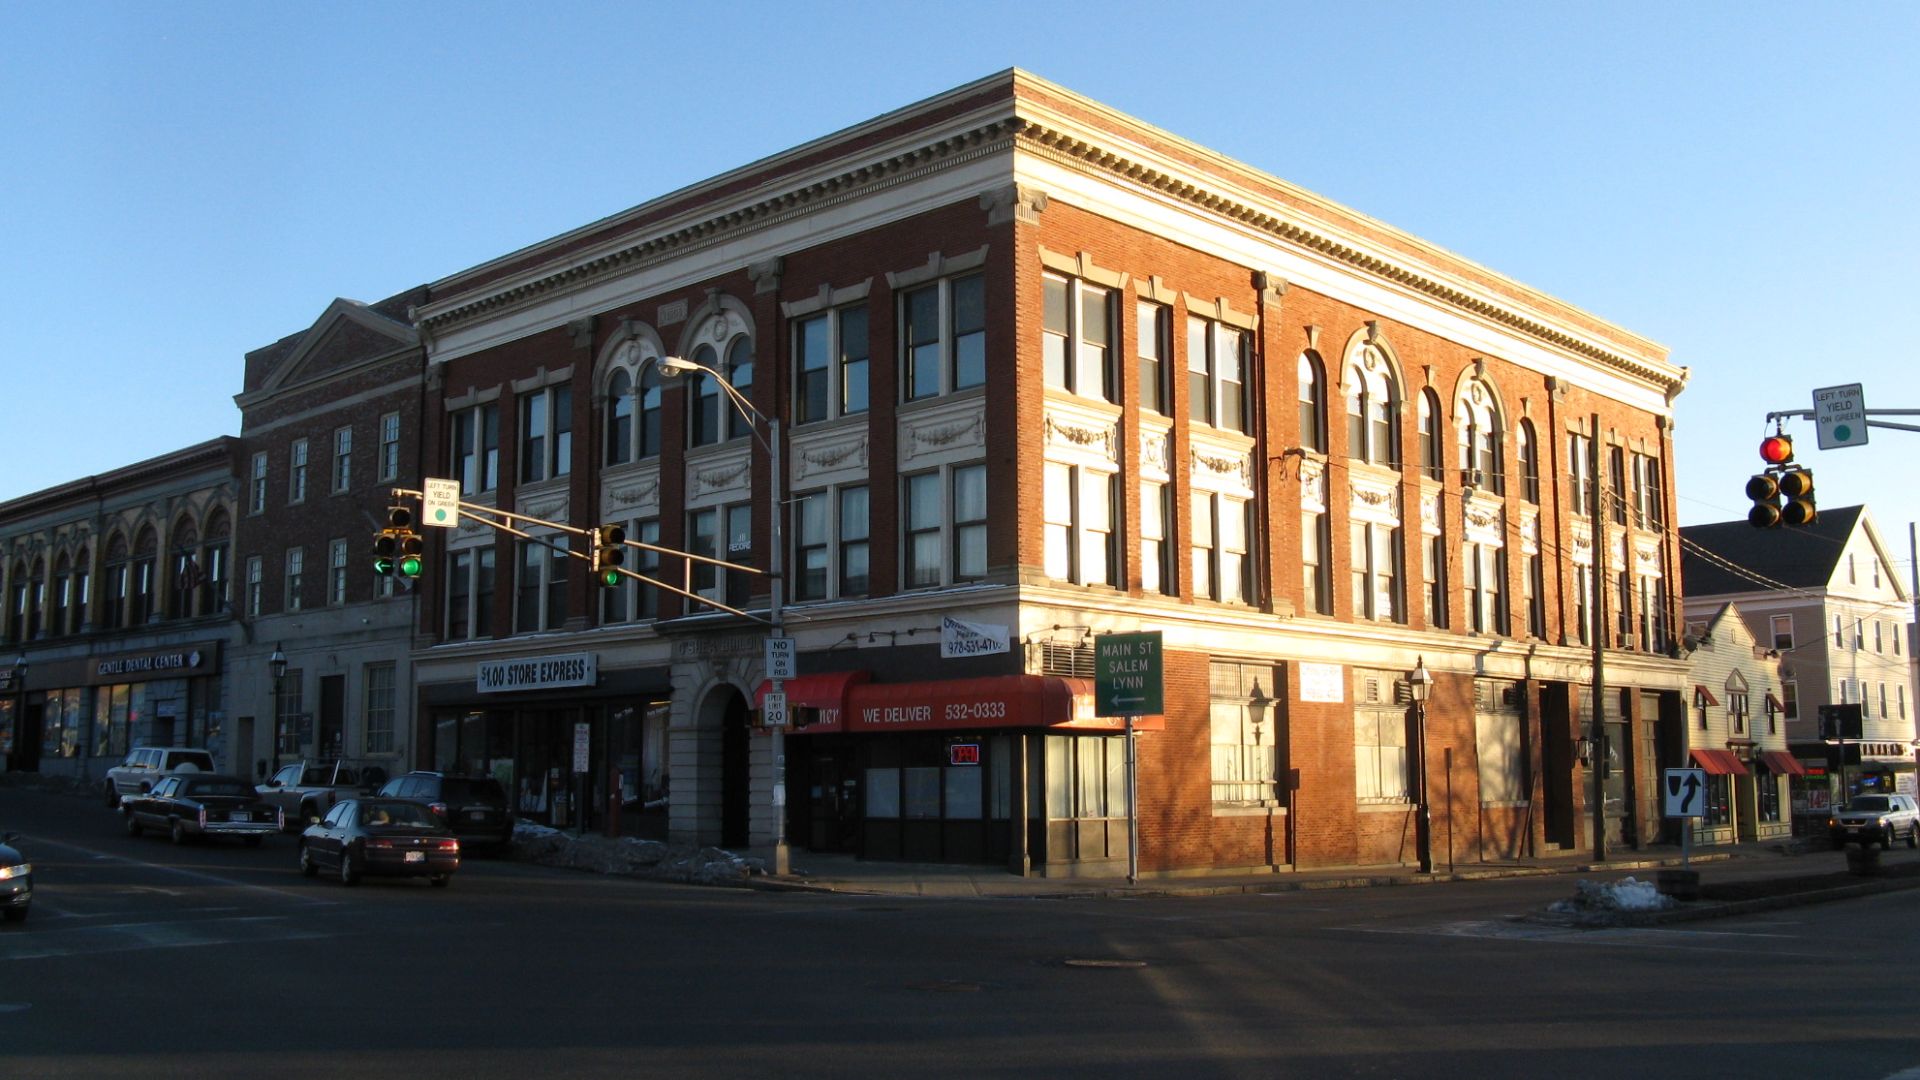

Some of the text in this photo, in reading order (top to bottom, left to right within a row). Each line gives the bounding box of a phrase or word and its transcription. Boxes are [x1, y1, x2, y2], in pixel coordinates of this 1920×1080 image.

[1816, 390, 1859, 401] LEFT TURN
[1827, 400, 1852, 412] YIELD
[1821, 412, 1860, 424] ON GREEN
[433, 491, 451, 499] YIELD
[773, 641, 788, 650] NO
[1102, 641, 1153, 656] MAIN ST
[97, 654, 183, 675] GENTLE DENTAL CENTER
[1109, 659, 1148, 673] SALEM
[481, 659, 585, 687] $1.00 STORE EXPRESS
[1113, 676, 1143, 690] LYNN
[768, 711, 782, 721] 20
[863, 702, 1006, 723] WE DELIVER 532-0333
